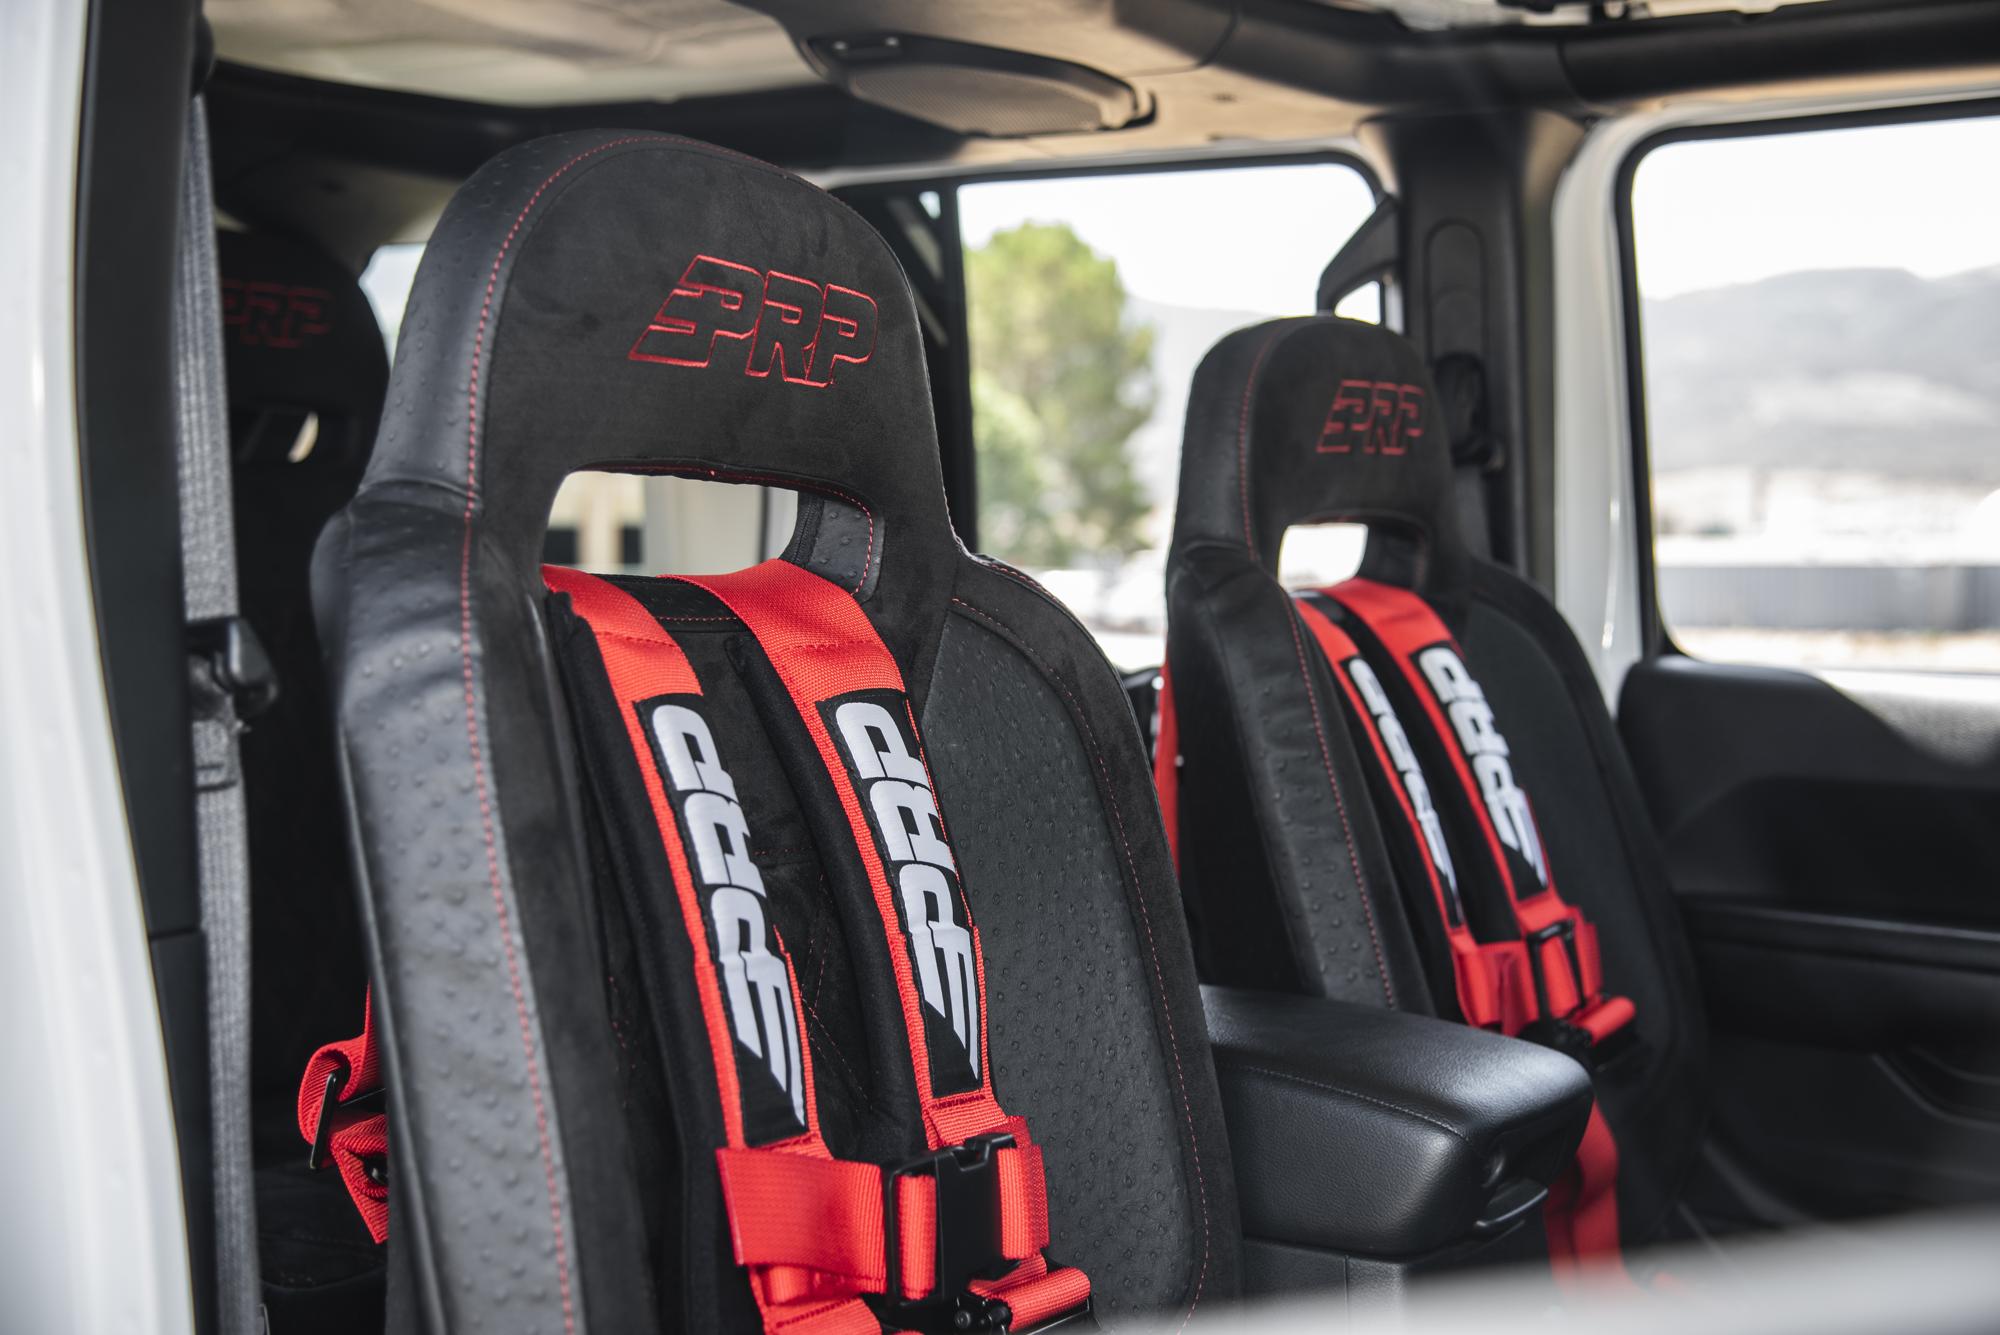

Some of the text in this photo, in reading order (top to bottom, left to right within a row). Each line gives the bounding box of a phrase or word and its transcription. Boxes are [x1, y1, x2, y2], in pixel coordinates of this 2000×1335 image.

[628, 254, 878, 388] PRP
[1314, 378, 1425, 455] PRP
[652, 703, 805, 1126] PRP
[835, 701, 979, 1080] PRP
